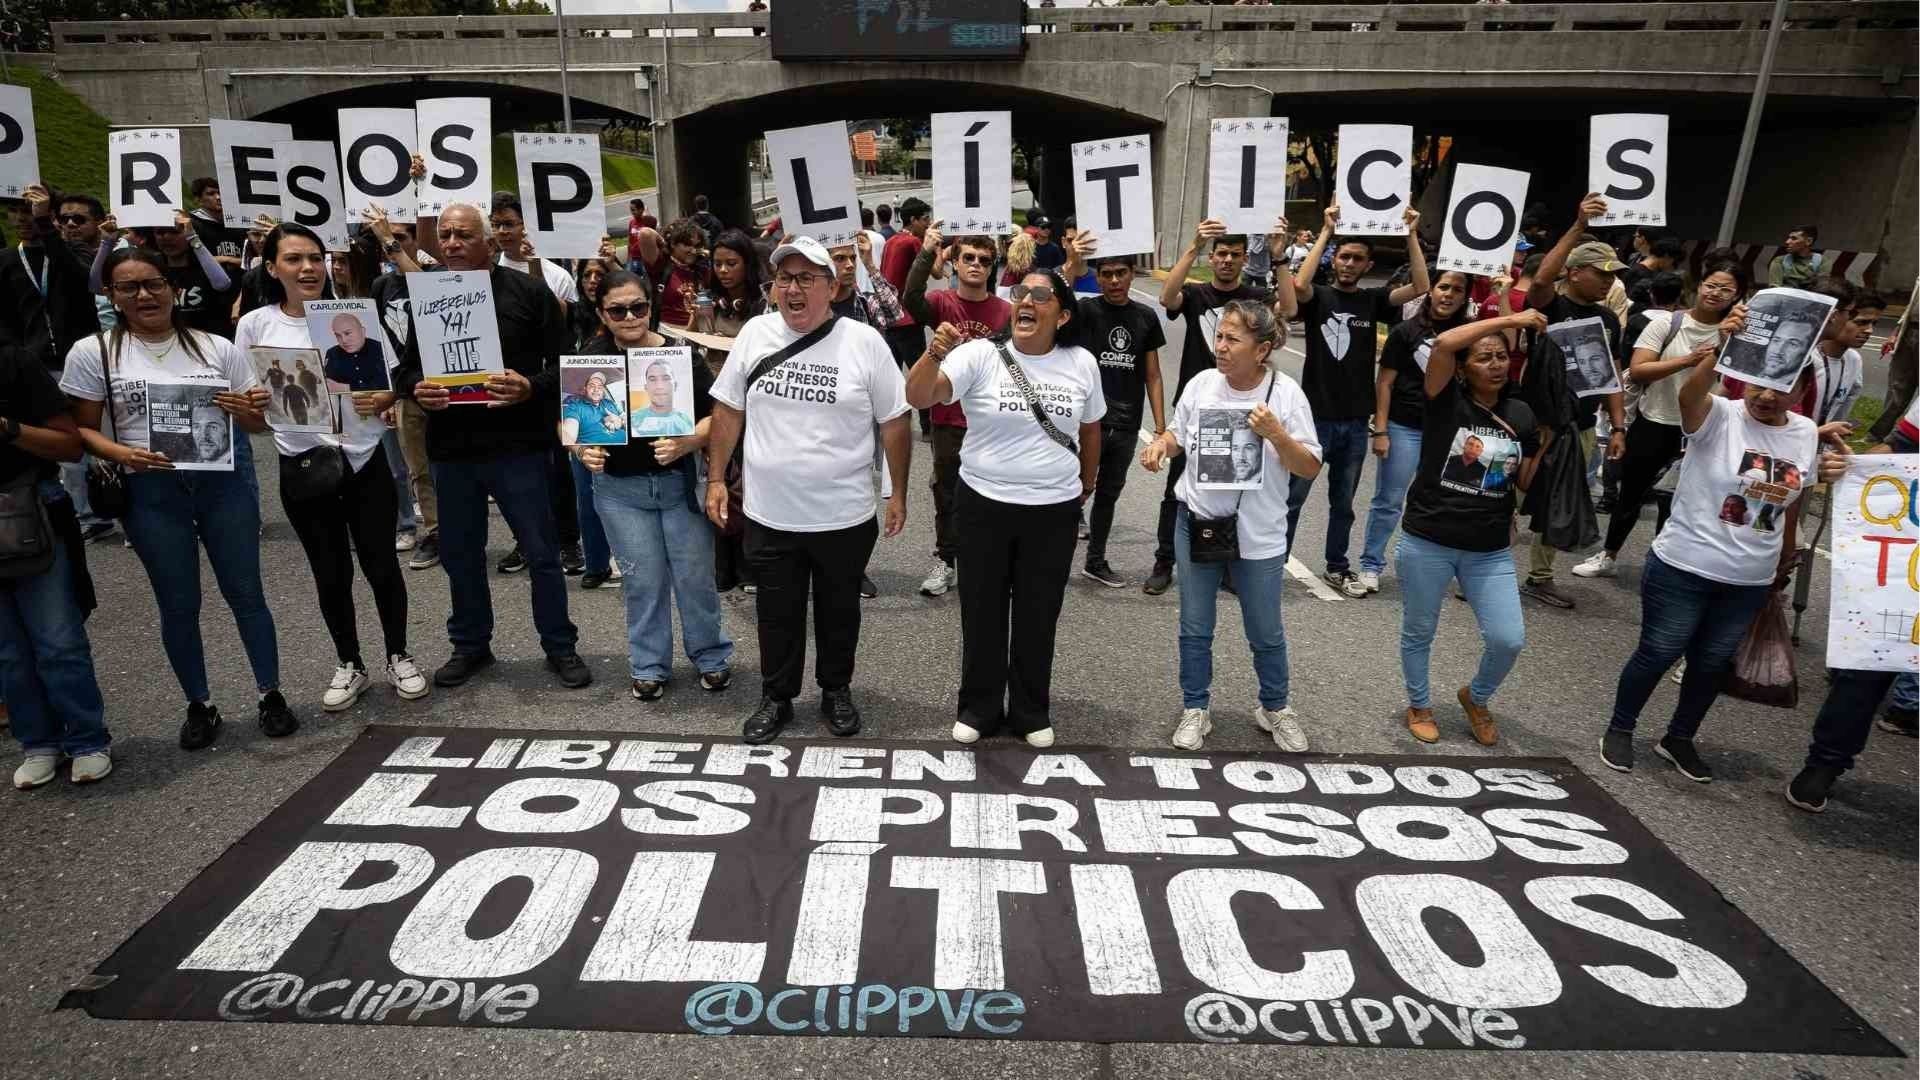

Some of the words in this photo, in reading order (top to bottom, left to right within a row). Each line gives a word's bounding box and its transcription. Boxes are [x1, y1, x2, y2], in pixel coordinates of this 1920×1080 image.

[120, 151, 172, 206] R
[230, 145, 282, 206] E
[346, 133, 413, 197] O
[430, 124, 478, 190] S
[964, 121, 990, 209] Í
[1239, 145, 1257, 209] I
[1346, 149, 1403, 211] C
[1604, 138, 1655, 201] S
[286, 165, 332, 227] S
[531, 161, 594, 232] P
[790, 157, 848, 225] L
[1085, 163, 1140, 231] T
[1451, 190, 1517, 251] O
[310, 303, 344, 311] CARLOS
[344, 302, 368, 310] VIDAL
[439, 311, 471, 337] YA!
[763, 367, 785, 380] OS
[786, 371, 838, 388] PRESOS
[800, 362, 807, 371] A
[809, 363, 839, 375] TODOS
[1000, 390, 1022, 398] LOS
[382, 736, 976, 782] LIBEREN
[1021, 753, 1106, 786] A
[1128, 755, 1570, 800] TODOS
[323, 773, 757, 836] LOS
[808, 785, 1630, 865] PRESOS
[176, 841, 1748, 1009] POLÍTICOS
